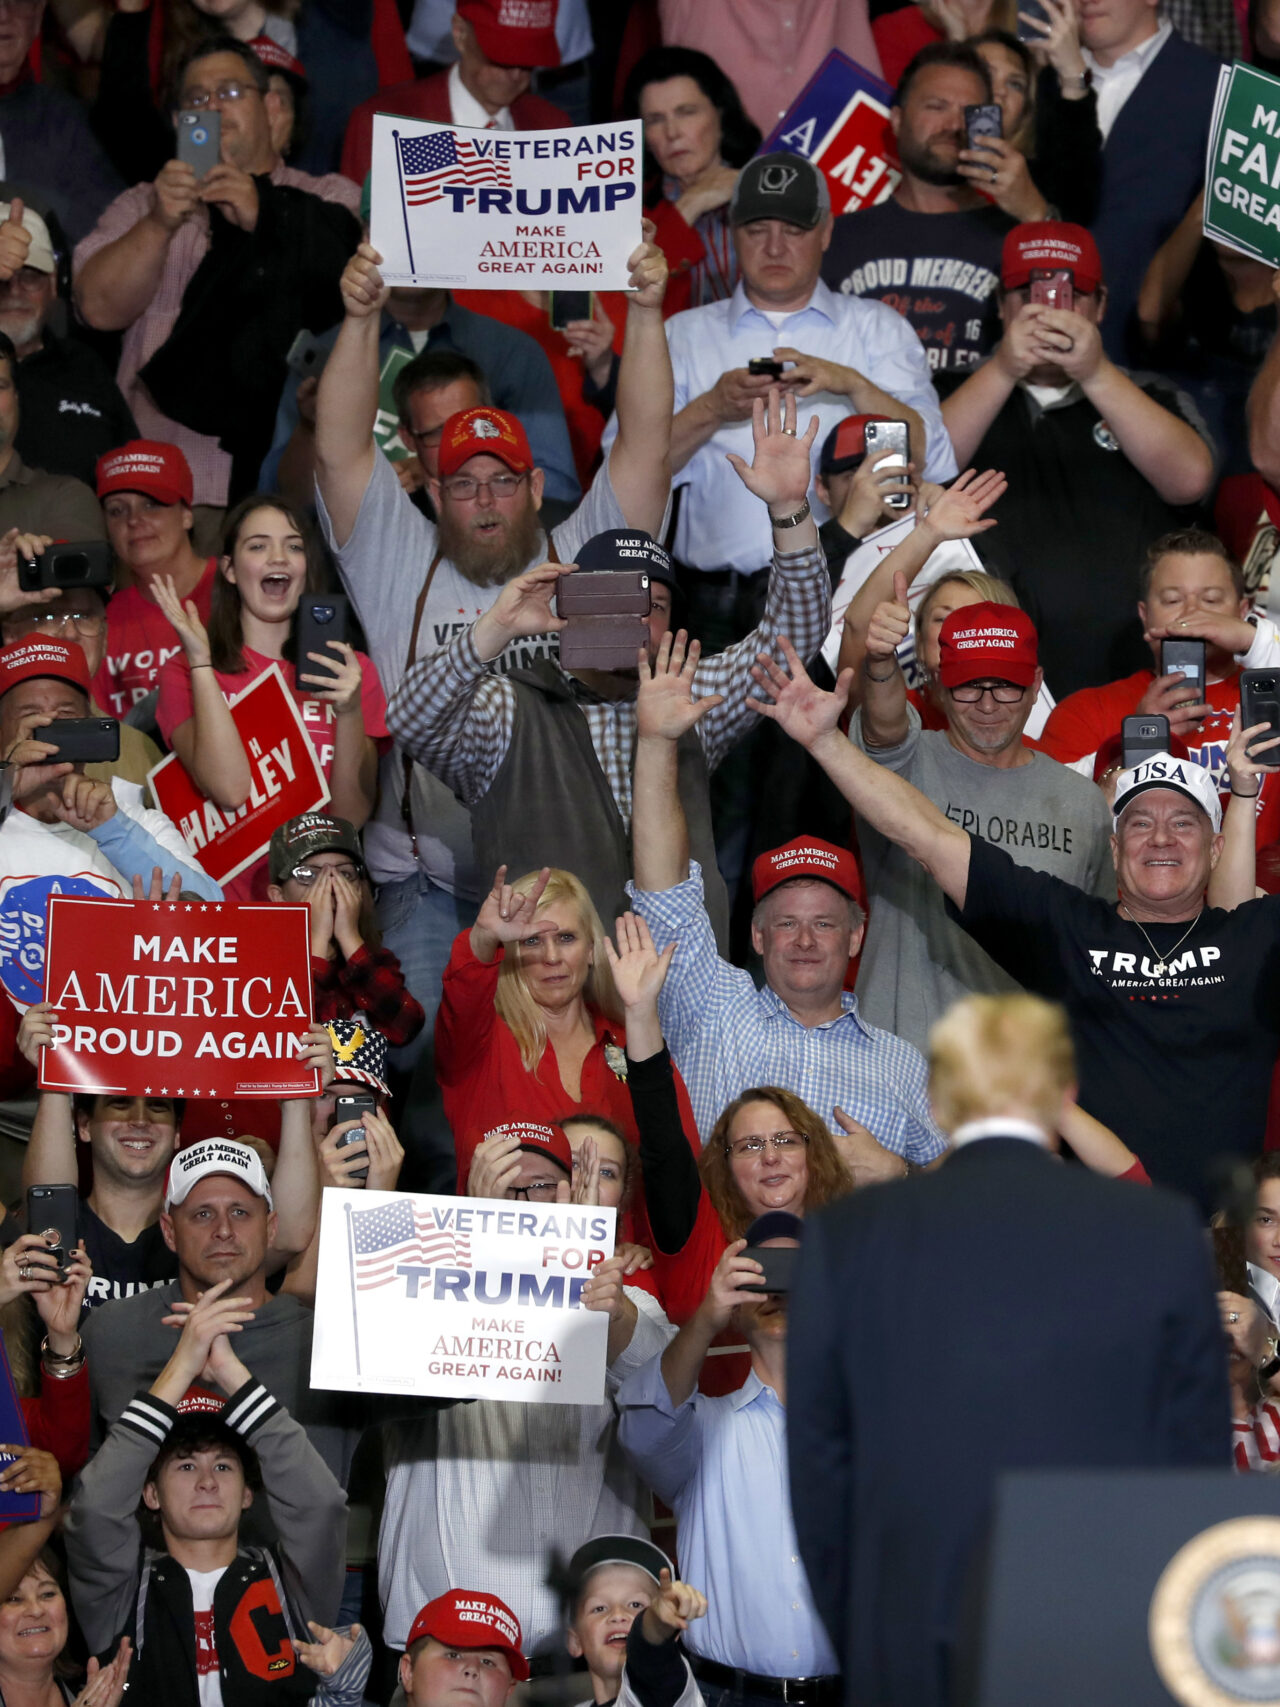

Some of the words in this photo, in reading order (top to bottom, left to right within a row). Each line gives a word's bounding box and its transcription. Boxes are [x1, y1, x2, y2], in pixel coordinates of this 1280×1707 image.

[471, 131, 635, 160] VETERANS
[577, 157, 635, 181] FOR
[442, 182, 637, 216] TRUMP
[516, 225, 566, 237] MAKE
[480, 240, 603, 259] AMERICA
[1018, 241, 1040, 251] MAKE
[1041, 239, 1082, 254] AMERICA
[1022, 249, 1048, 260] GREAT
[1049, 249, 1079, 262] AGAIN
[478, 262, 536, 274] GREAT
[541, 262, 604, 274] AGAIN!
[841, 258, 908, 298] PROUD
[911, 258, 1001, 301] MEMBER
[616, 539, 641, 547] MAKE
[644, 541, 670, 562] AMERICA
[619, 549, 649, 558] GREAT
[651, 553, 670, 569] AGAIN
[952, 629, 977, 640] MAKE
[977, 628, 1019, 639] AMERICA
[957, 639, 985, 649] GREAT
[986, 639, 1015, 649] AGAIN
[1, 647, 26, 663] MAKE
[27, 644, 70, 656] AMERICA
[7, 655, 36, 669] GREAT
[37, 653, 66, 663] AGAIN
[106, 645, 181, 677] WOM
[1132, 761, 1189, 785] USA
[188, 737, 297, 857] HALEY
[290, 818, 334, 833] TRUMP
[945, 803, 1073, 856] EPLORABLE
[771, 850, 797, 863] MAKE
[797, 848, 840, 863] AMERICA
[776, 857, 804, 870] GREAT
[806, 857, 836, 870] AGAIN
[132, 934, 239, 964] MAKE
[1089, 946, 1221, 978] TRUMP
[1111, 978, 1155, 988] AMERICA
[1158, 977, 1190, 987] GREAT
[1191, 975, 1226, 986] AGAIN!
[51, 970, 307, 1019] AMERICA
[51, 1024, 182, 1058] PROUD
[195, 1031, 309, 1060] AGAIN
[483, 1124, 509, 1141] MAKE
[511, 1121, 554, 1136] AMERICA
[521, 1131, 550, 1142] AGAIN
[179, 1146, 205, 1165] MAKE
[207, 1144, 252, 1162] AMERICA
[183, 1153, 214, 1172] GREAT
[217, 1152, 248, 1170] AGAIN
[431, 1207, 608, 1241] VETERANS
[542, 1247, 606, 1271] FOR
[88, 1276, 177, 1300] RUM
[396, 1265, 585, 1310] TRUMP
[471, 1317, 525, 1335] MAKE
[430, 1335, 562, 1363] AMERICA
[428, 1362, 491, 1379] GREAT
[496, 1366, 563, 1383] AGAIN!
[455, 1600, 486, 1612] MAKE
[488, 1605, 519, 1637] AMERICA
[459, 1611, 494, 1626] GREAT
[495, 1620, 517, 1646] AGAIN
